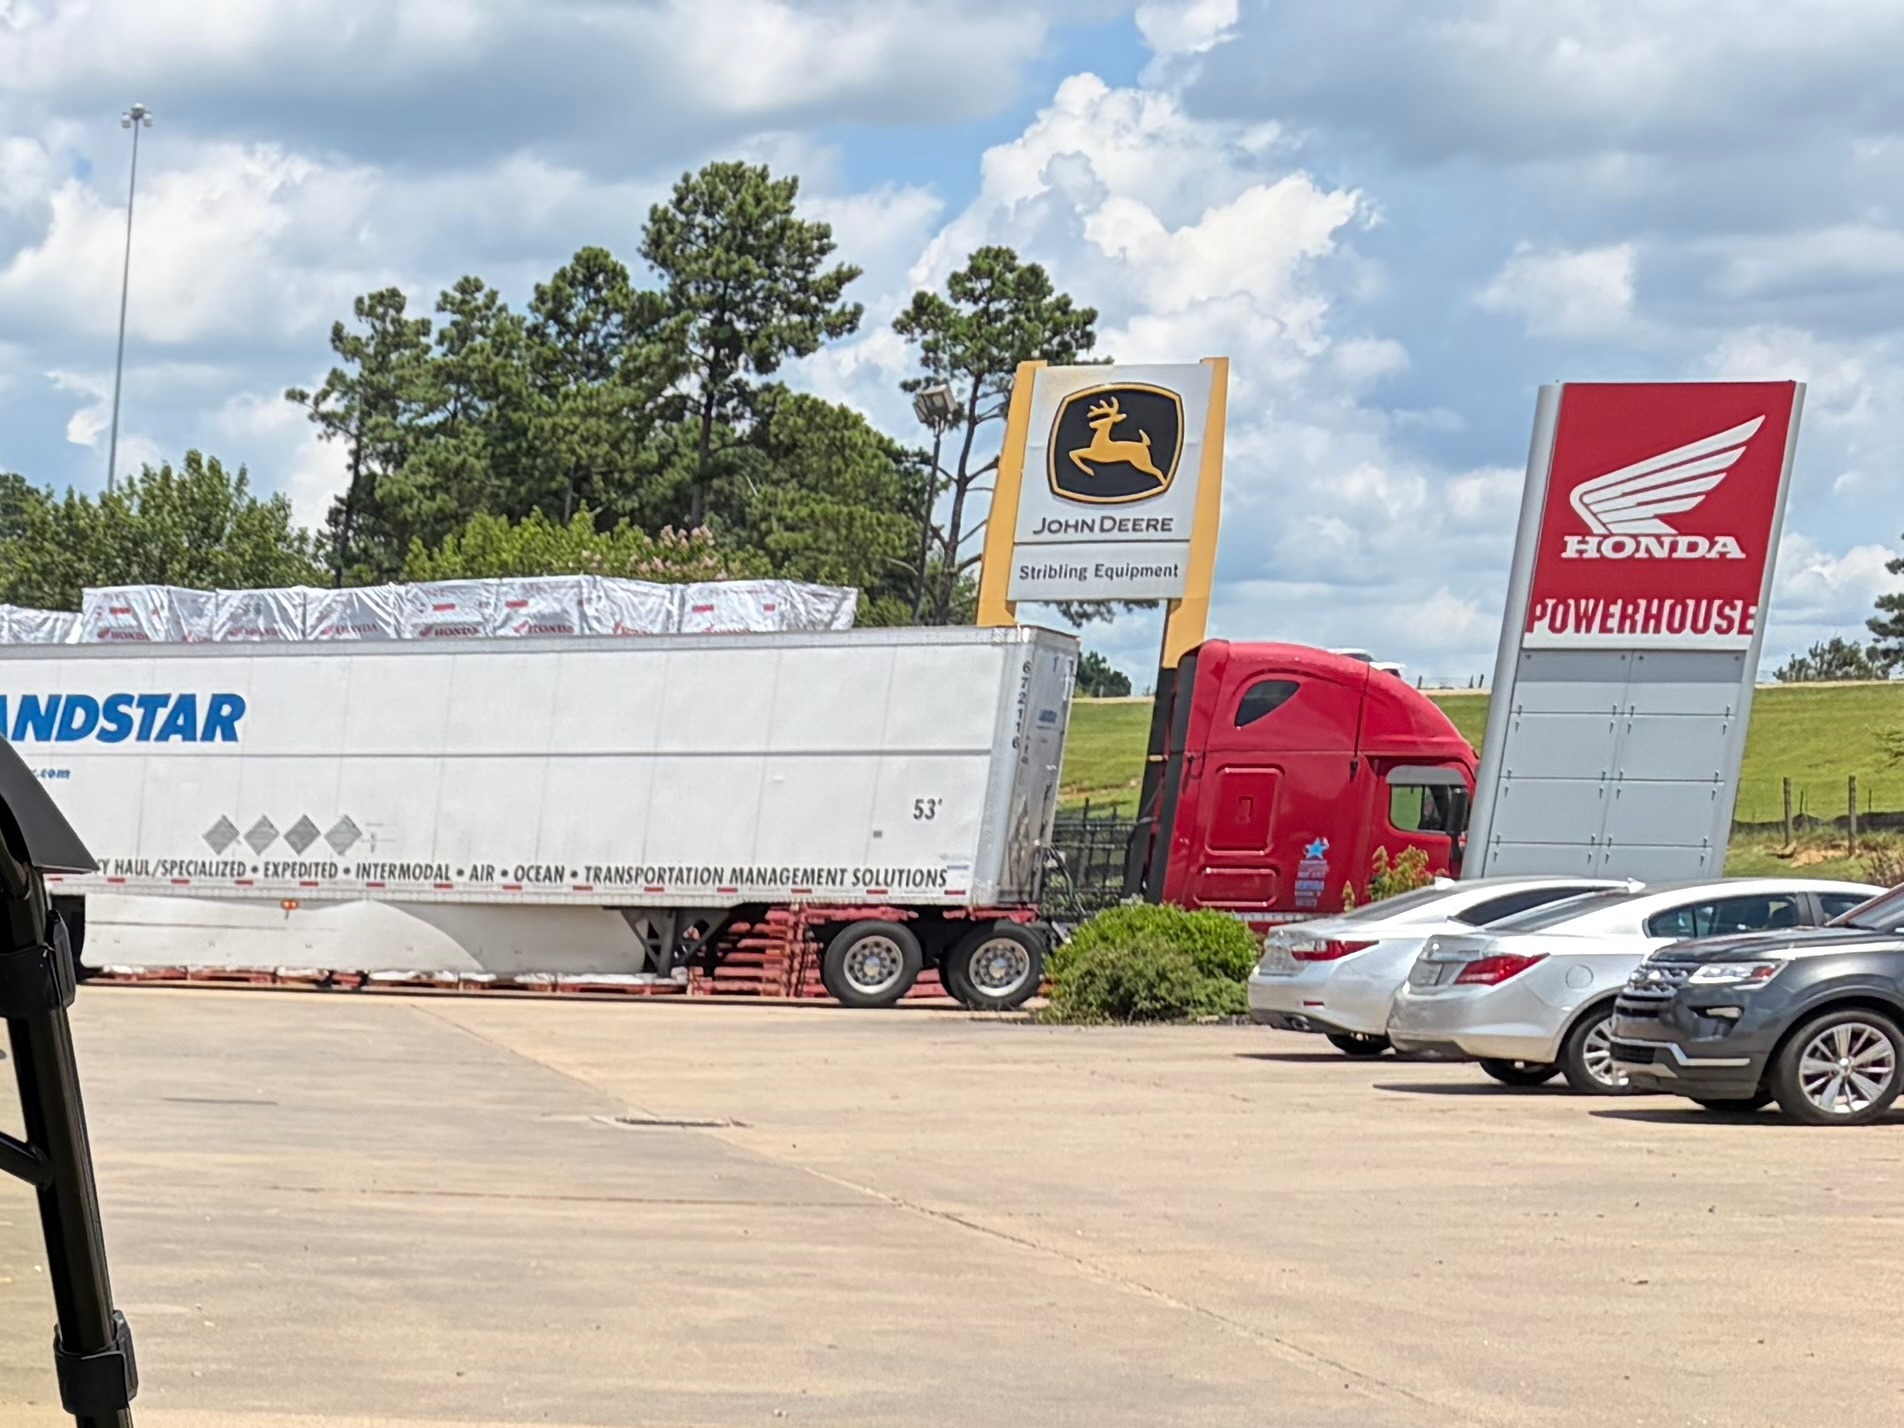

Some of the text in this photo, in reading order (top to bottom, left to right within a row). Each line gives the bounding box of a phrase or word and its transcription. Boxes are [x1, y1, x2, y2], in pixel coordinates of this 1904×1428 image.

[1032, 515, 1174, 536] JOHN DEERE
[1561, 534, 1746, 561] HONDA
[1018, 562, 1180, 584] Stribling Equipment
[1526, 598, 1756, 636] POWERHOUSE
[114, 858, 247, 879] HAUL/SPECIALIZED
[263, 861, 339, 880] EXPEDITED
[355, 862, 452, 881] INTERMODAL
[469, 863, 495, 882] AIR
[514, 864, 565, 883] OCEAN
[584, 866, 724, 887] TRANSPORTATION
[728, 867, 848, 888] MANAGEMENT
[852, 868, 948, 889] SOLUTIONS
